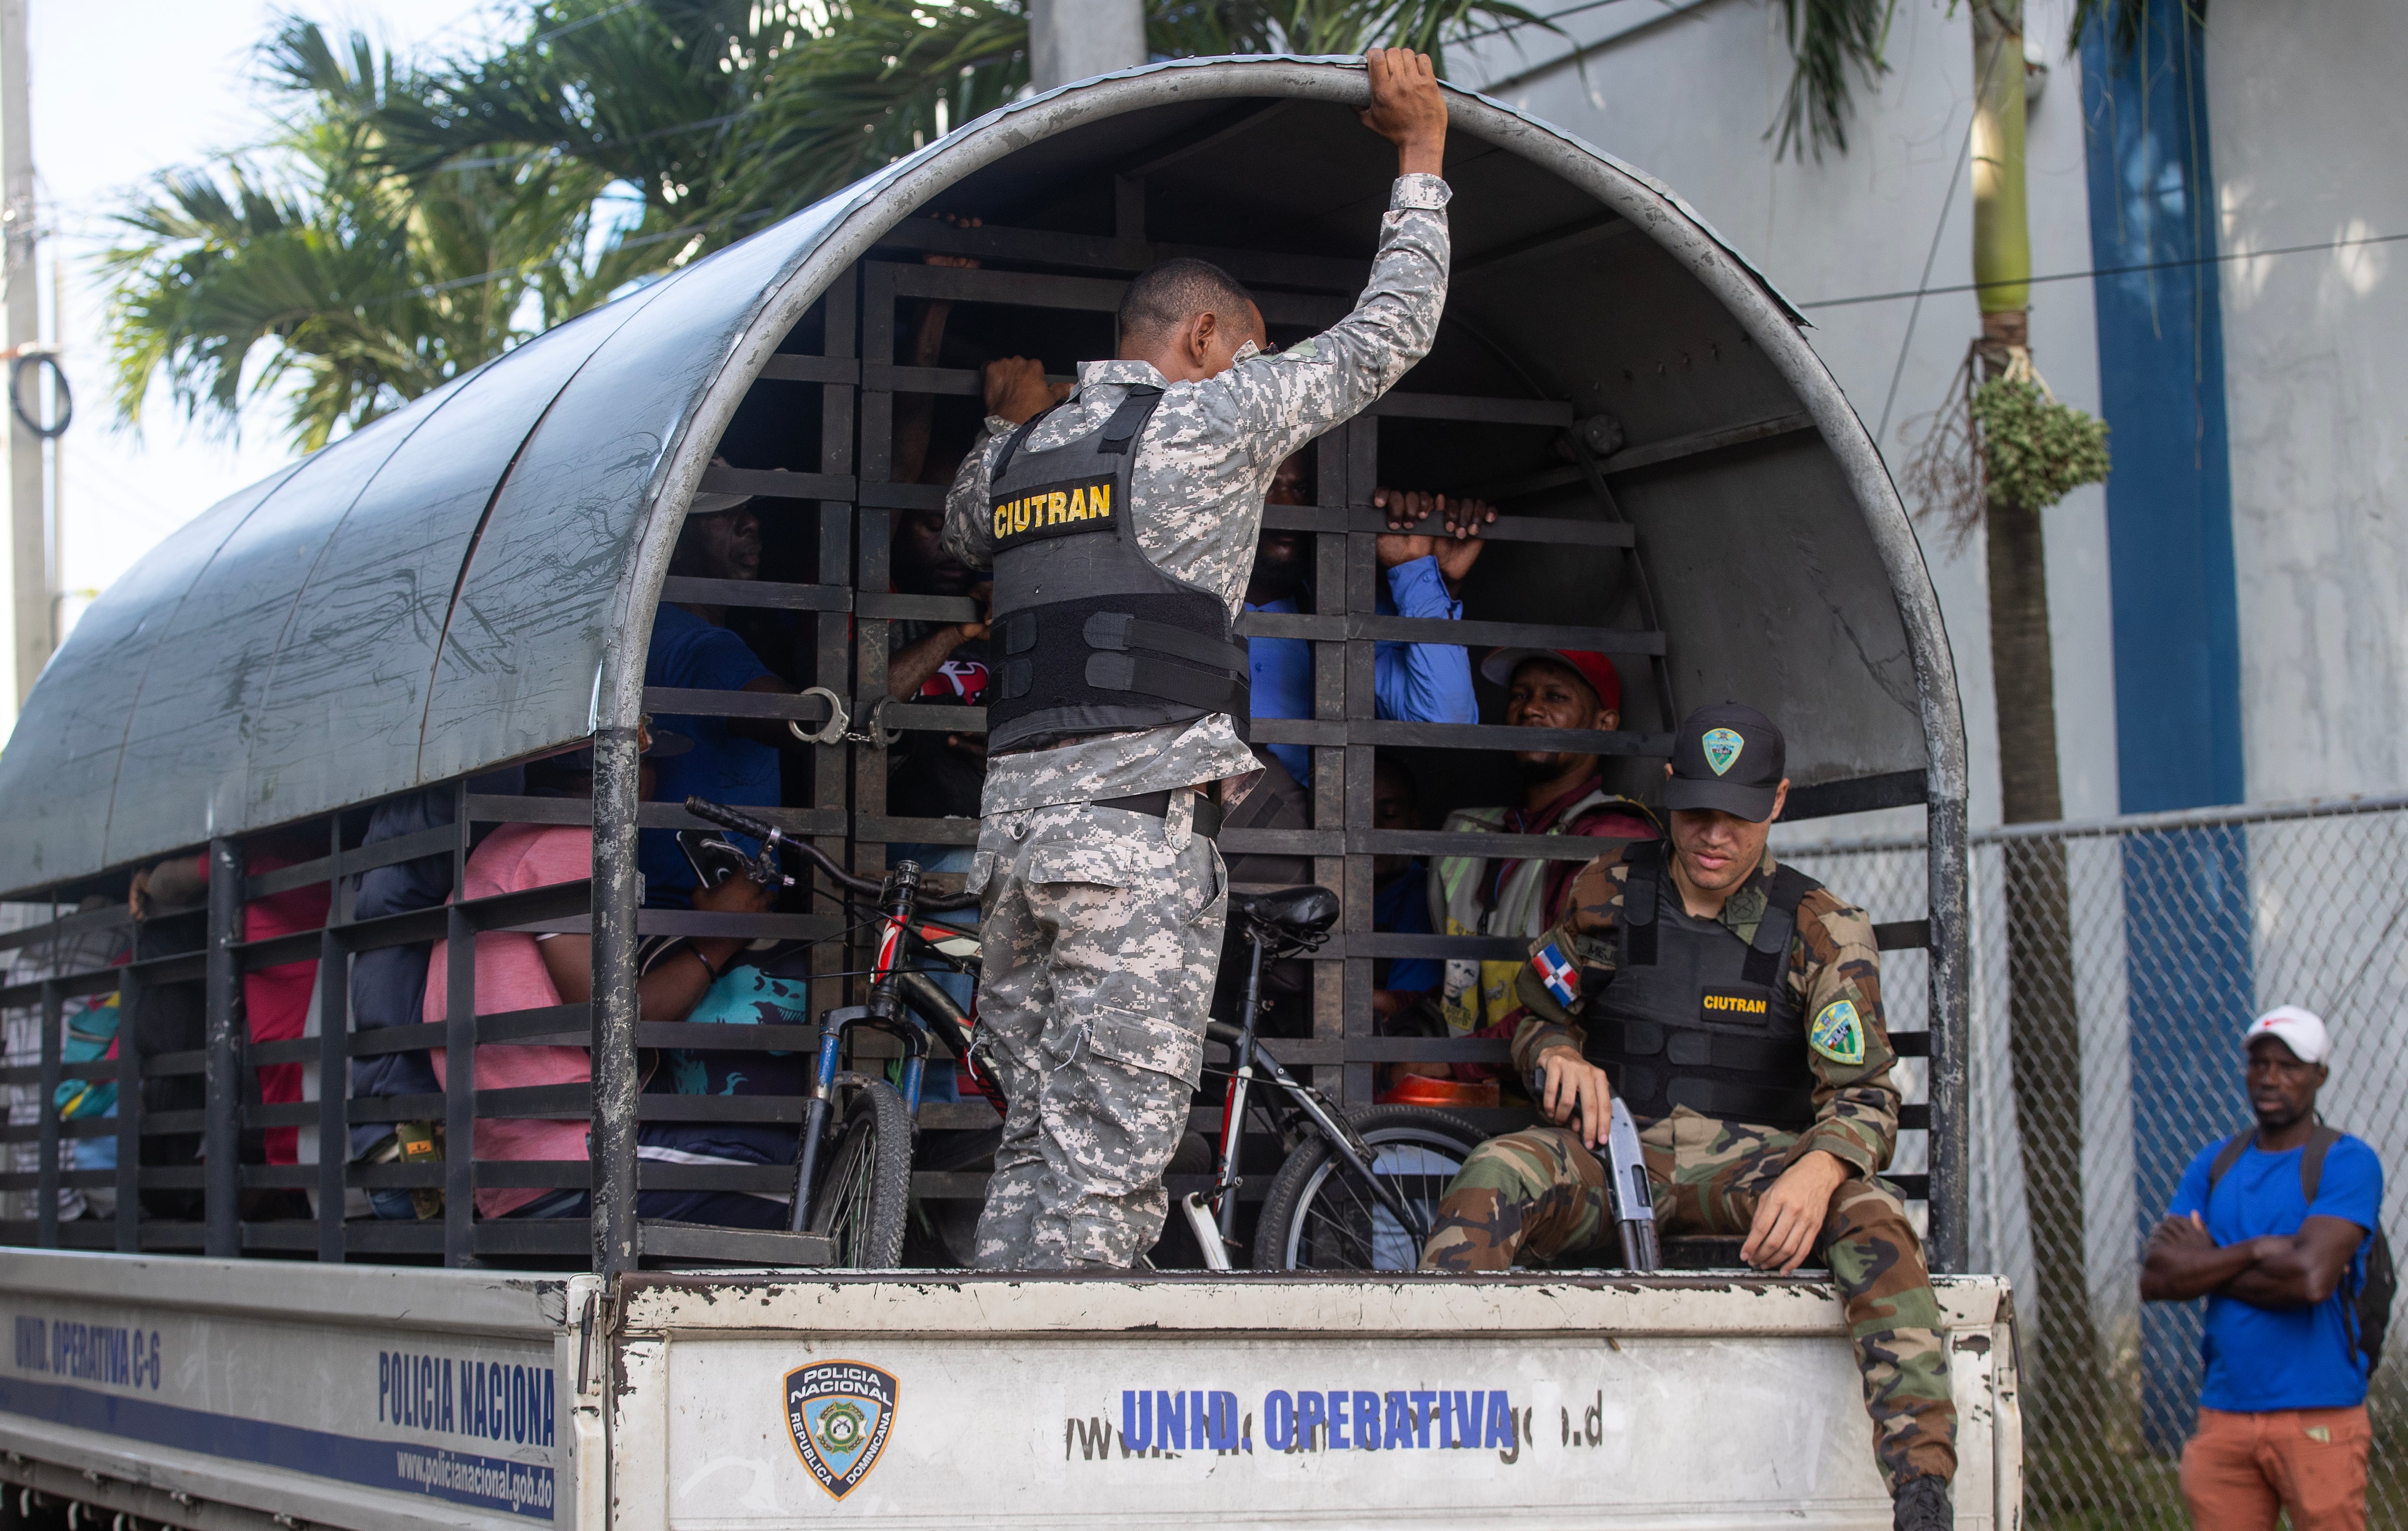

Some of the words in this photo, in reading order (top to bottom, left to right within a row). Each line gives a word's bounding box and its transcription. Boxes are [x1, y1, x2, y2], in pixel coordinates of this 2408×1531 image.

[994, 484, 1110, 539] CIUTRAN
[1703, 995, 1767, 1014] CIUTRAN
[52, 1319, 130, 1386] OPERATIVA
[133, 1328, 161, 1391] C-6
[804, 1367, 881, 1387] POLICIA
[379, 1351, 454, 1433] POLICIA
[460, 1360, 554, 1448] NACIONA
[790, 1380, 893, 1407] NACIONAL
[1122, 1390, 1252, 1451] UNID.
[1264, 1389, 1514, 1451] OPERATIVA
[790, 1412, 833, 1486] REPUBLICA
[846, 1412, 891, 1485] DOMINICANA
[397, 1450, 552, 1512] www.policianacional.gob.do
